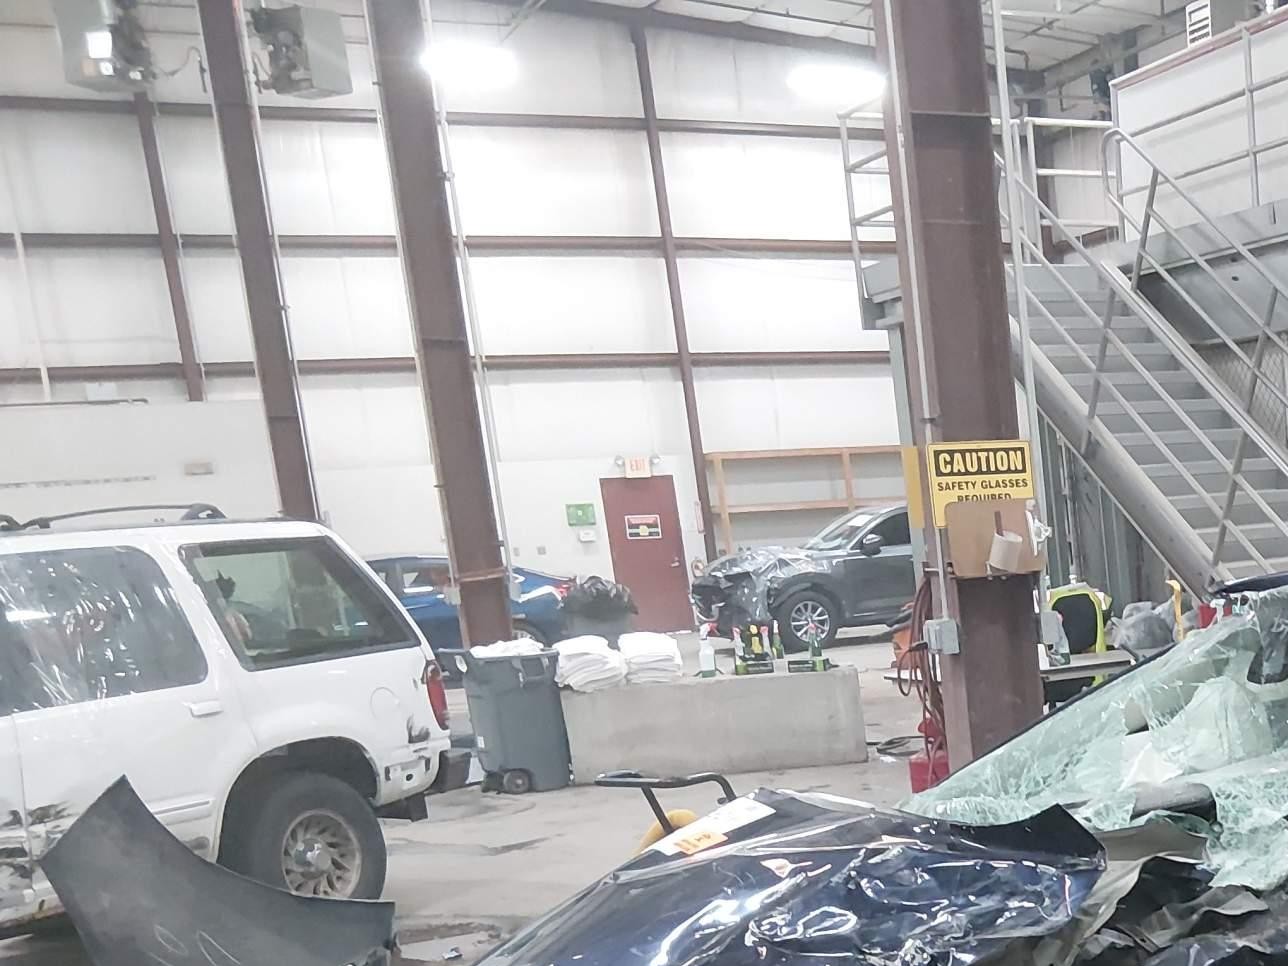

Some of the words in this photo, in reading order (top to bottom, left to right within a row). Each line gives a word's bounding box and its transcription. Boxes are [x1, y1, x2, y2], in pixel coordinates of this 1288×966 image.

[938, 450, 1023, 474] CAUTION
[937, 480, 977, 492] SAFETY
[981, 478, 1028, 490] GLASSES
